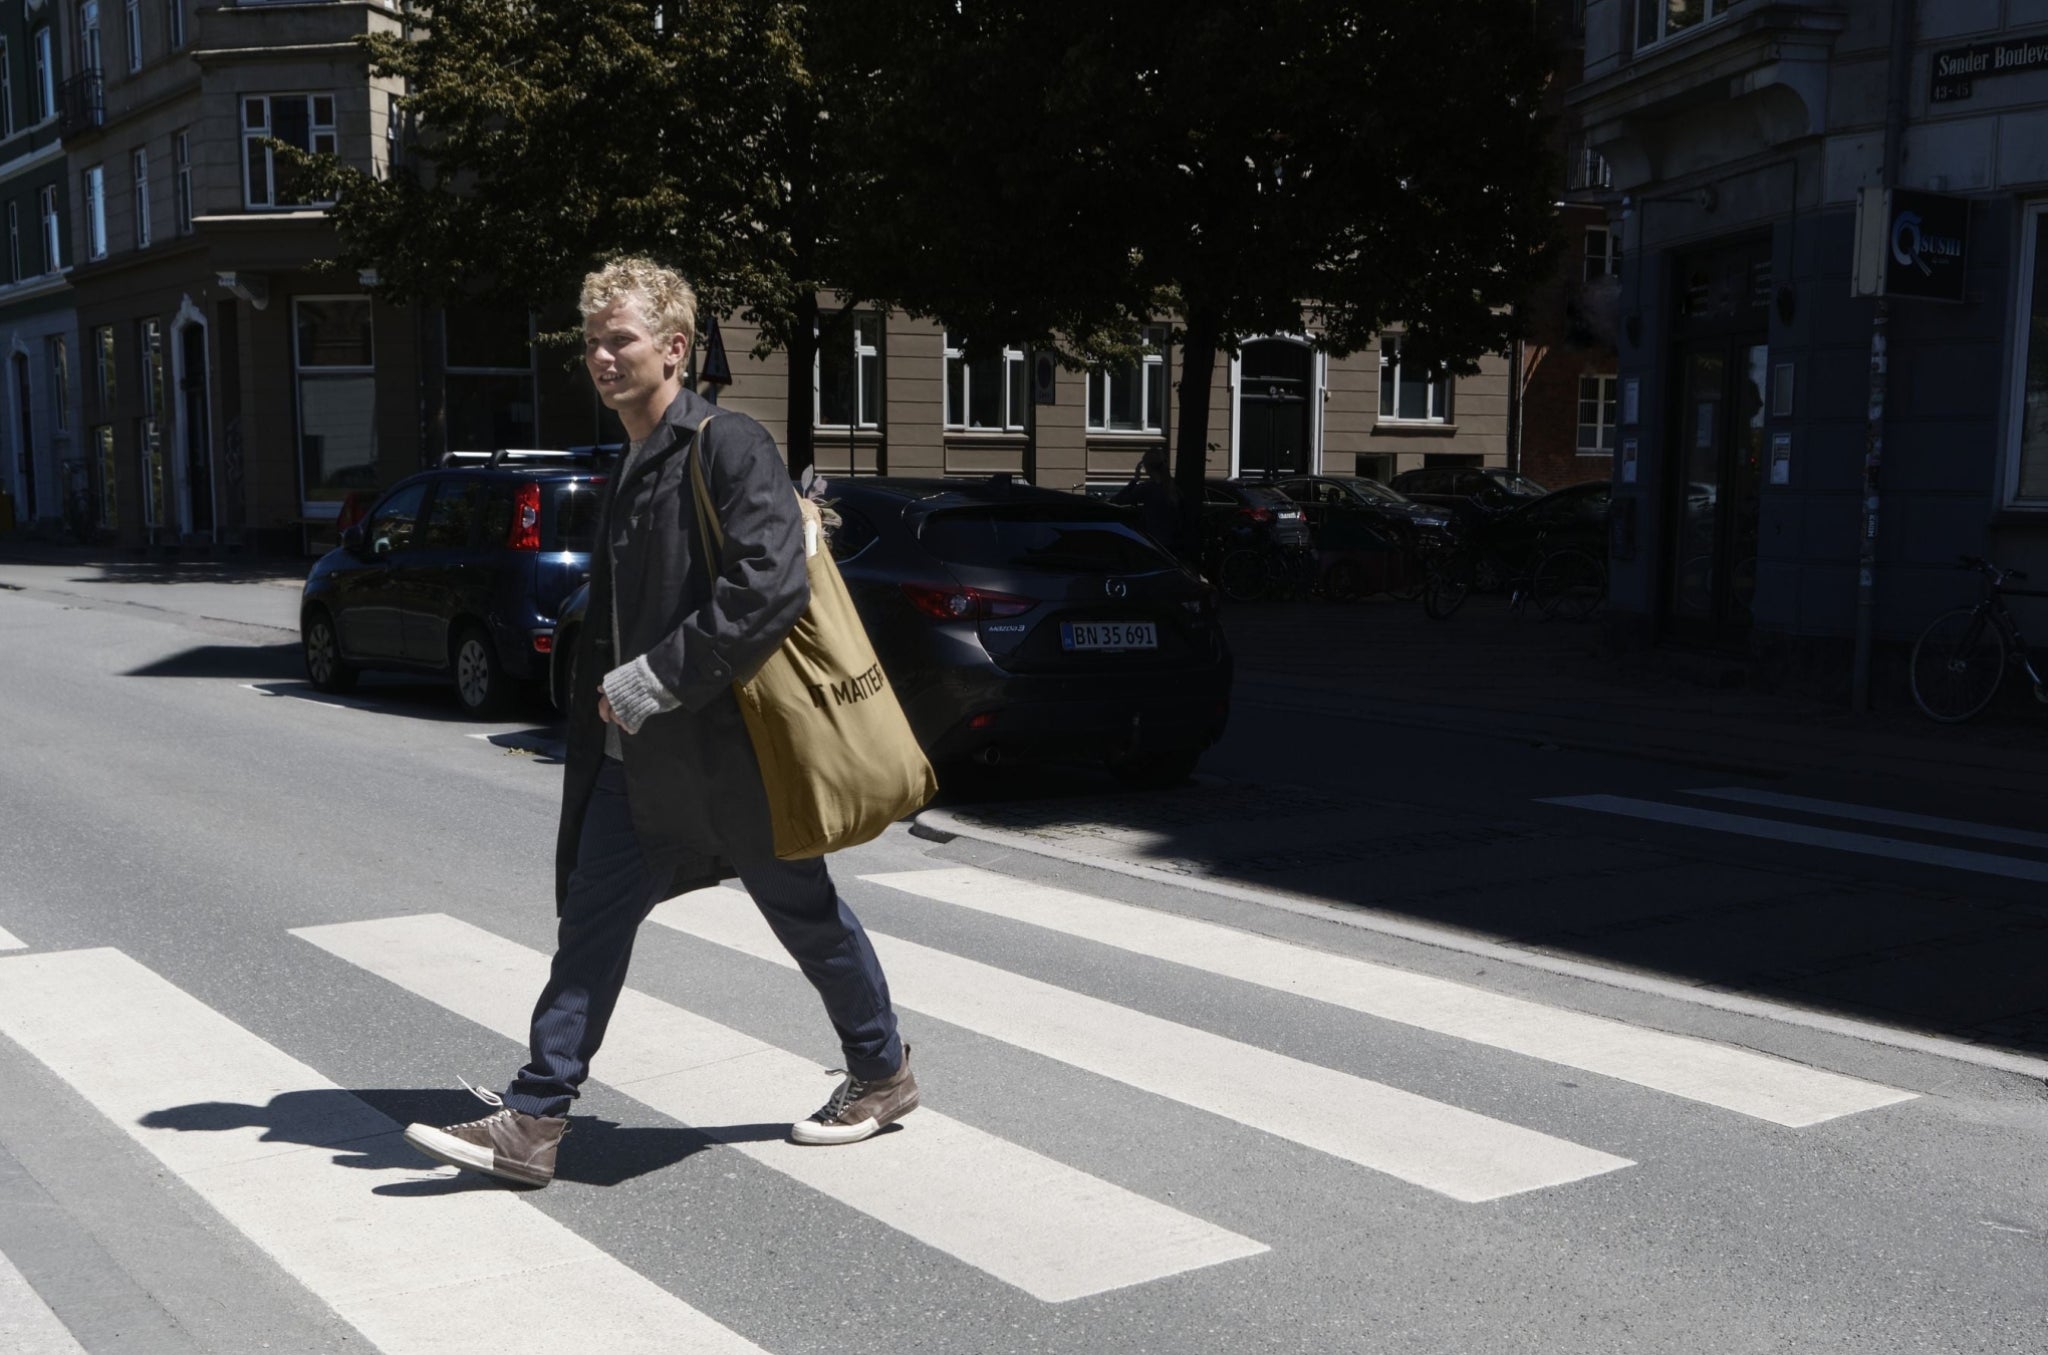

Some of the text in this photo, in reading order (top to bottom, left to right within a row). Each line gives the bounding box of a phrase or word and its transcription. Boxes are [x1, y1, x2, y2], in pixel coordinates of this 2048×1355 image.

[1938, 50, 1990, 77] Sønder
[1074, 626, 1098, 644] BN
[1103, 626, 1121, 644] 35
[1126, 626, 1153, 645] 691
